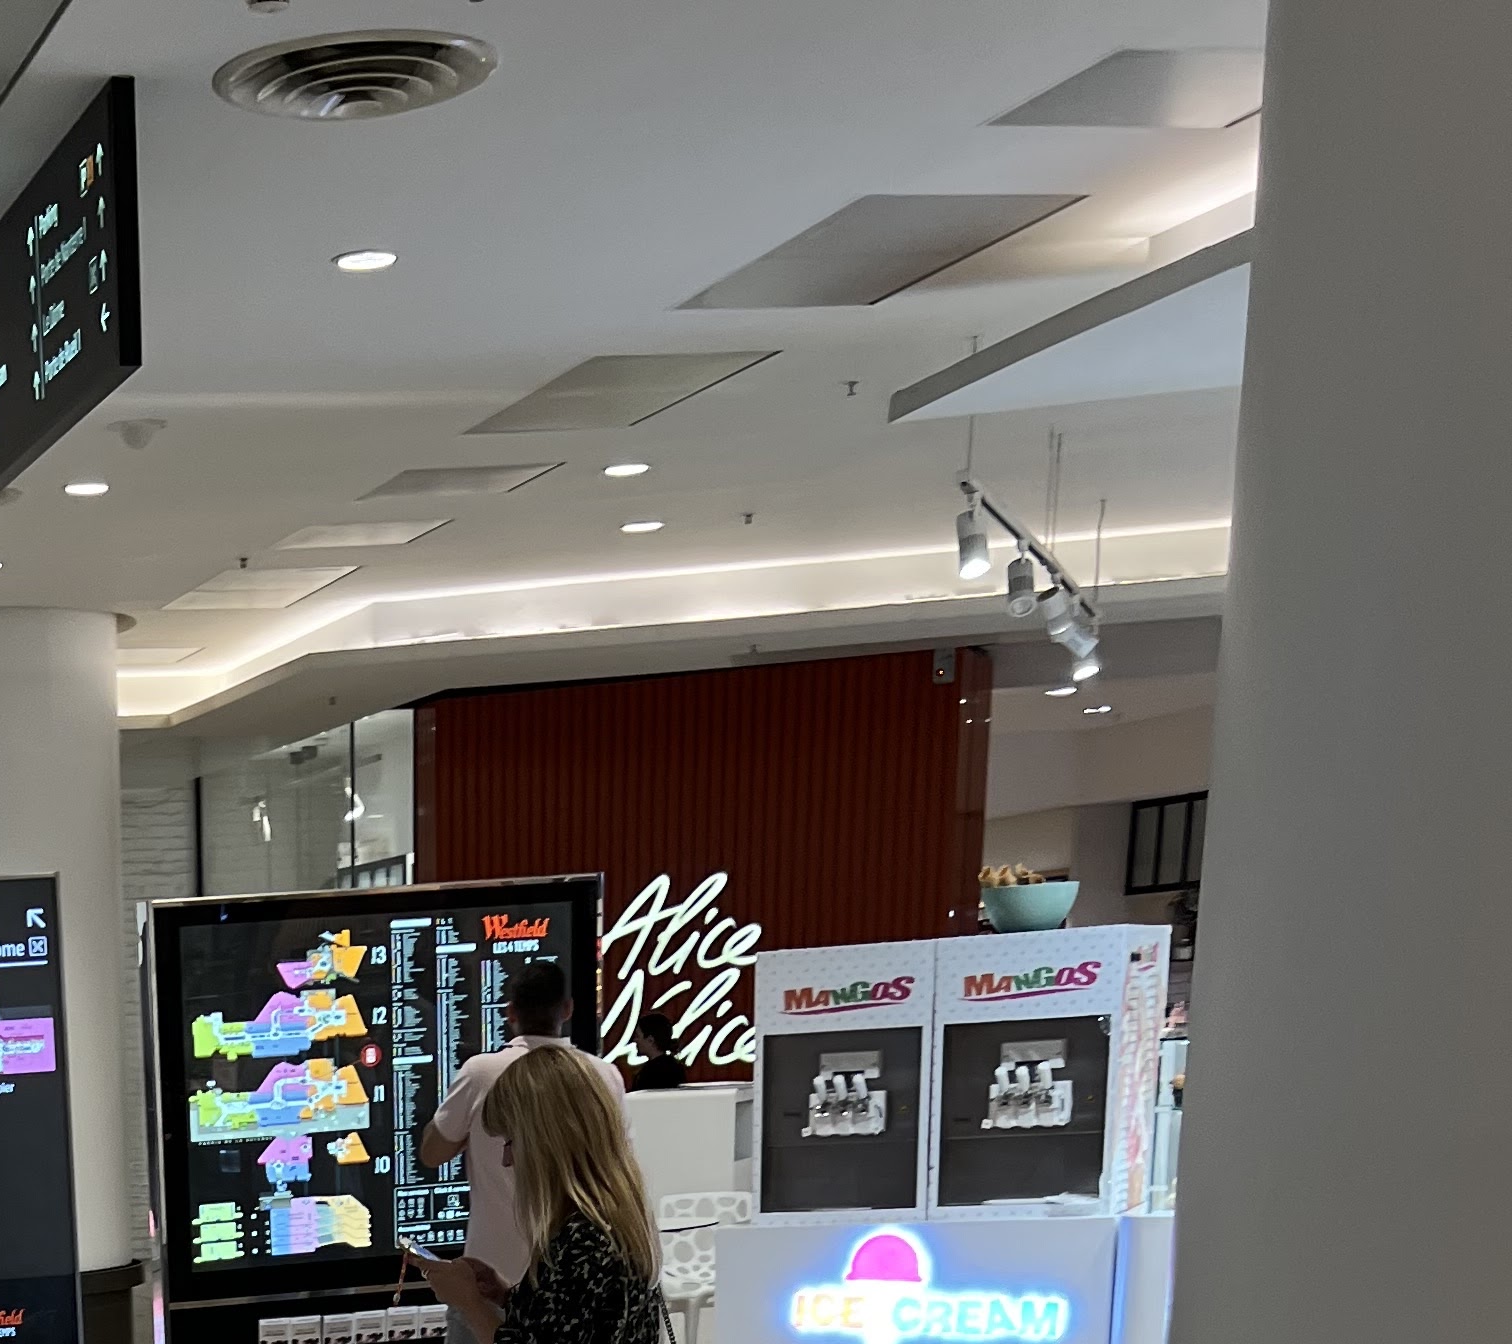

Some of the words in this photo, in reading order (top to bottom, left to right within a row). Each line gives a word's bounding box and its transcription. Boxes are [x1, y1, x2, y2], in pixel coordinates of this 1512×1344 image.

[481, 914, 550, 940] Westfield
[601, 872, 762, 980] Alice
[793, 1294, 864, 1328] ICE
[892, 1297, 1059, 1337] CREAM
